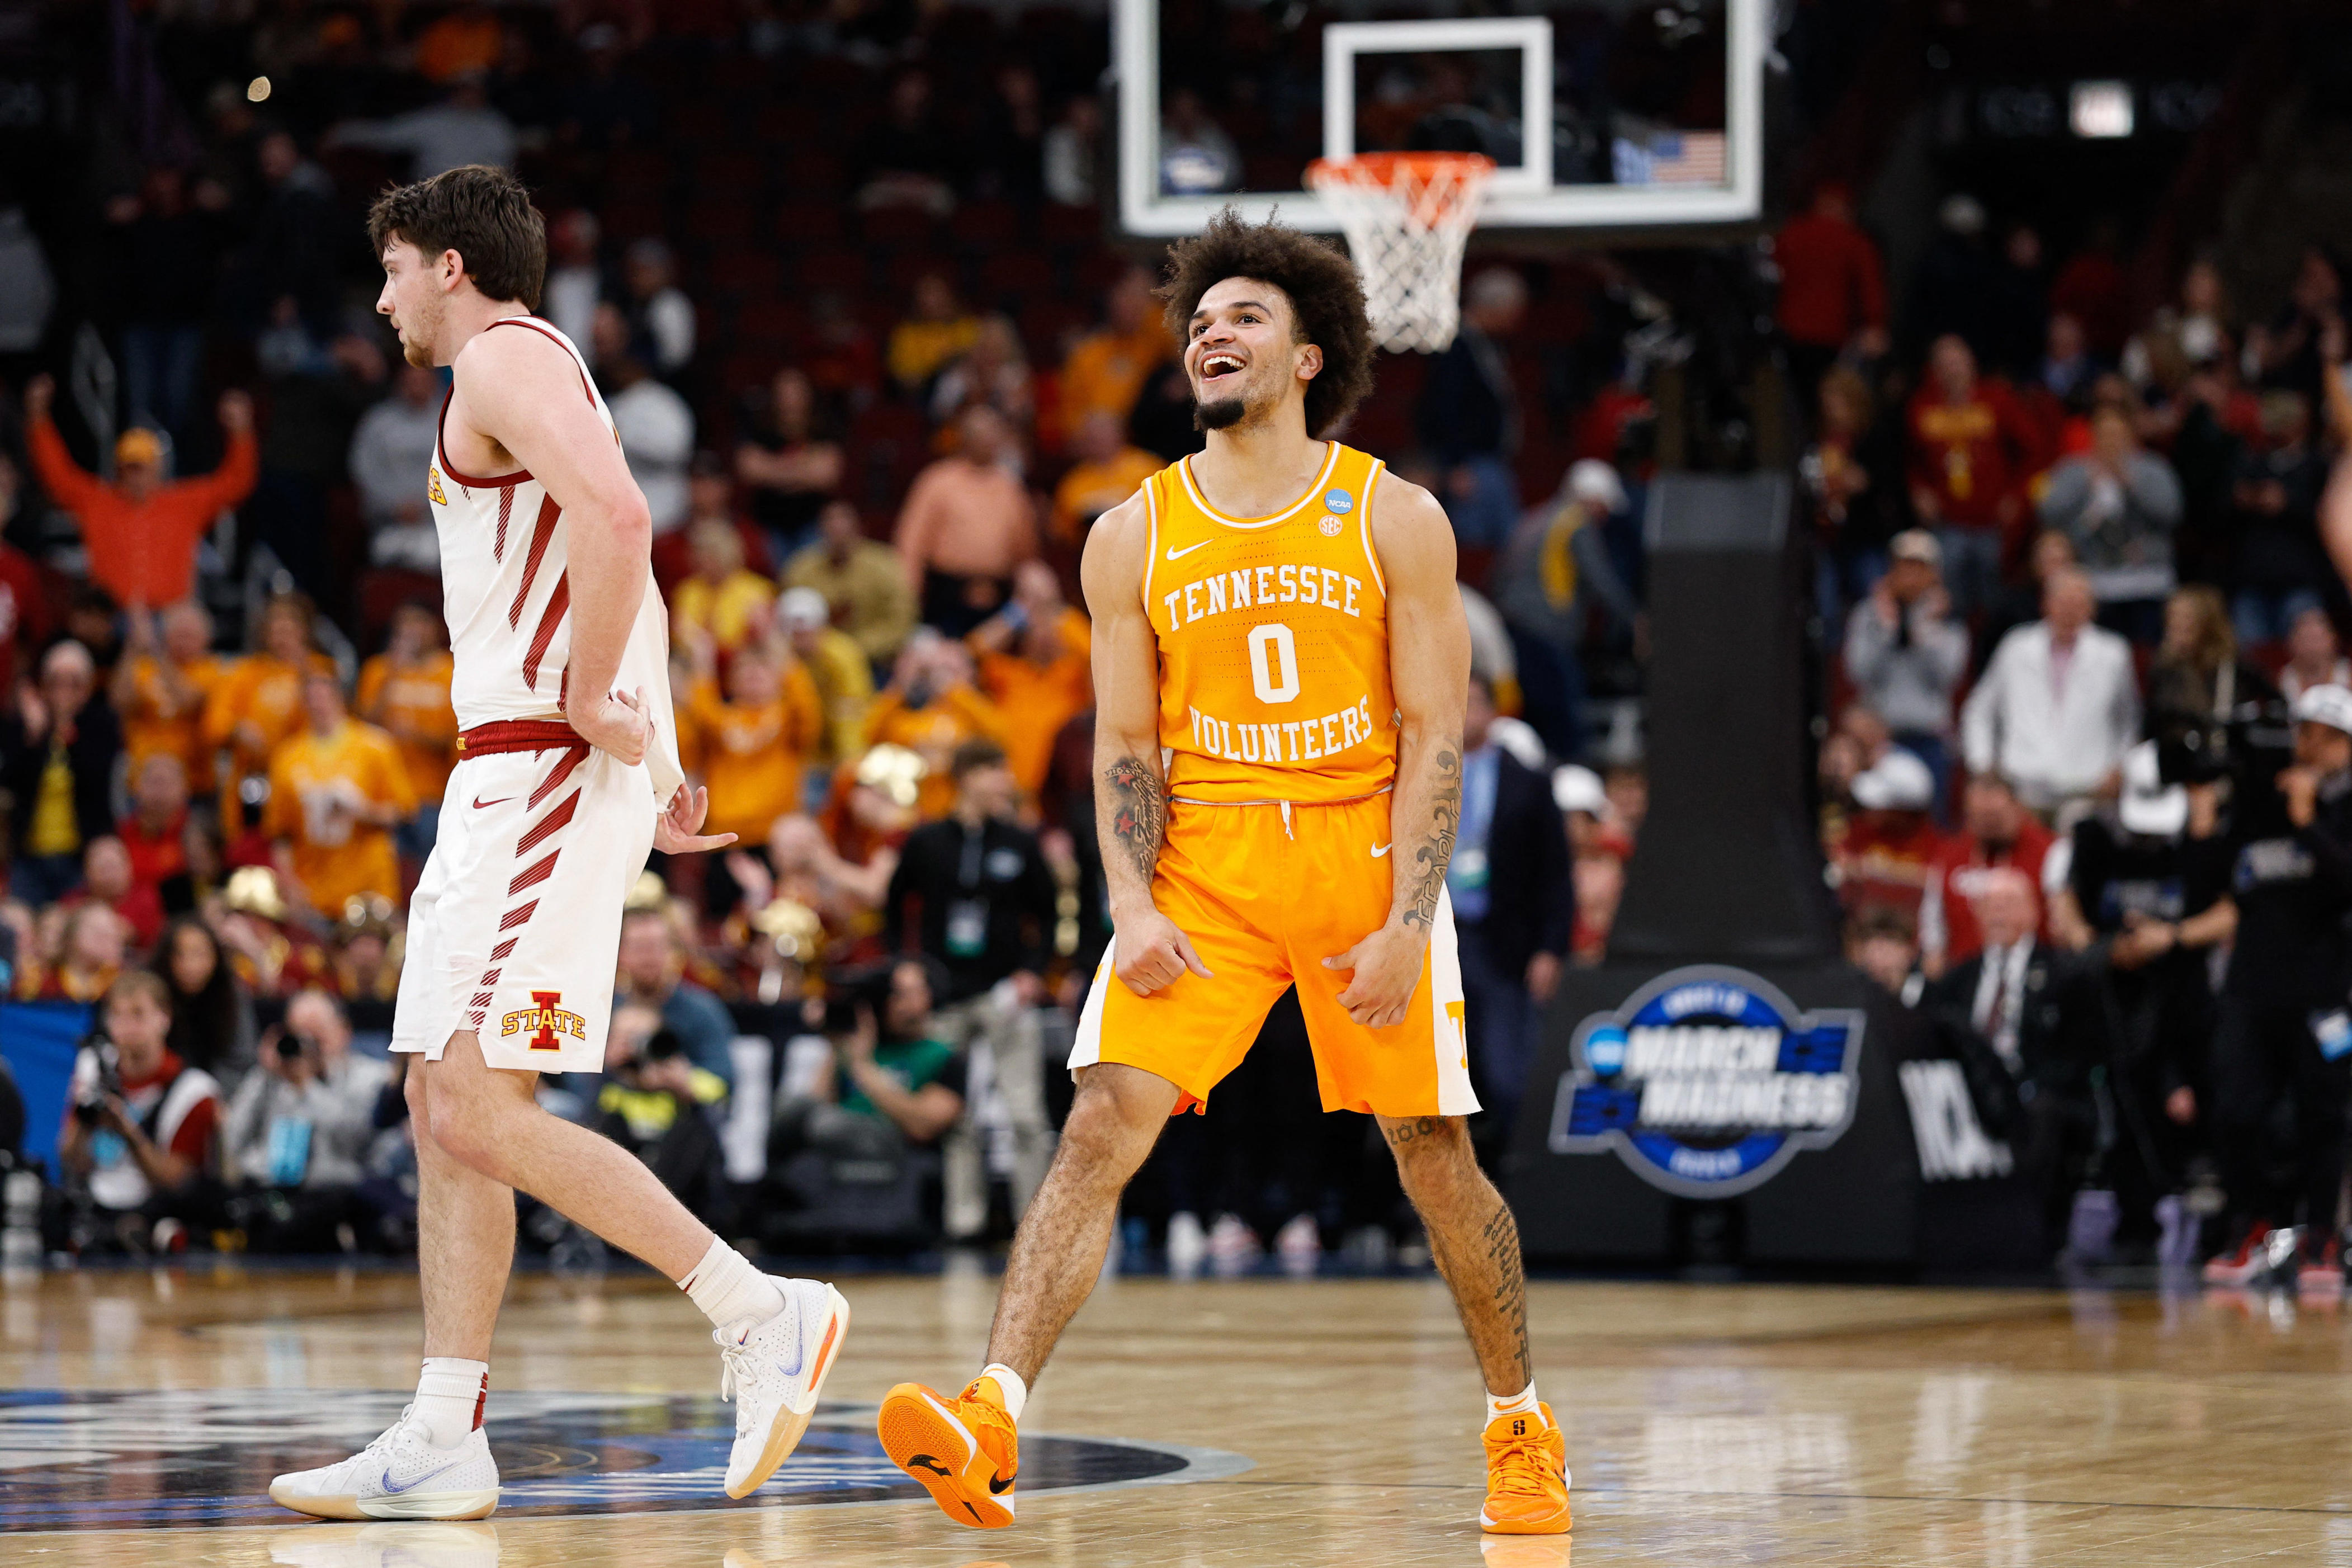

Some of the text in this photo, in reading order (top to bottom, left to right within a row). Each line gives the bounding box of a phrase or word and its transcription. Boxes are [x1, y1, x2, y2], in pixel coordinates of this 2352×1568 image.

[1321, 517, 1340, 535] SEC
[1328, 499, 1351, 509] NCAA
[1164, 564, 1362, 632] TENNESSEE
[1247, 622, 1300, 704] 0
[1189, 693, 1373, 762] VOLUNTEERS
[501, 1008, 585, 1041] STATE
